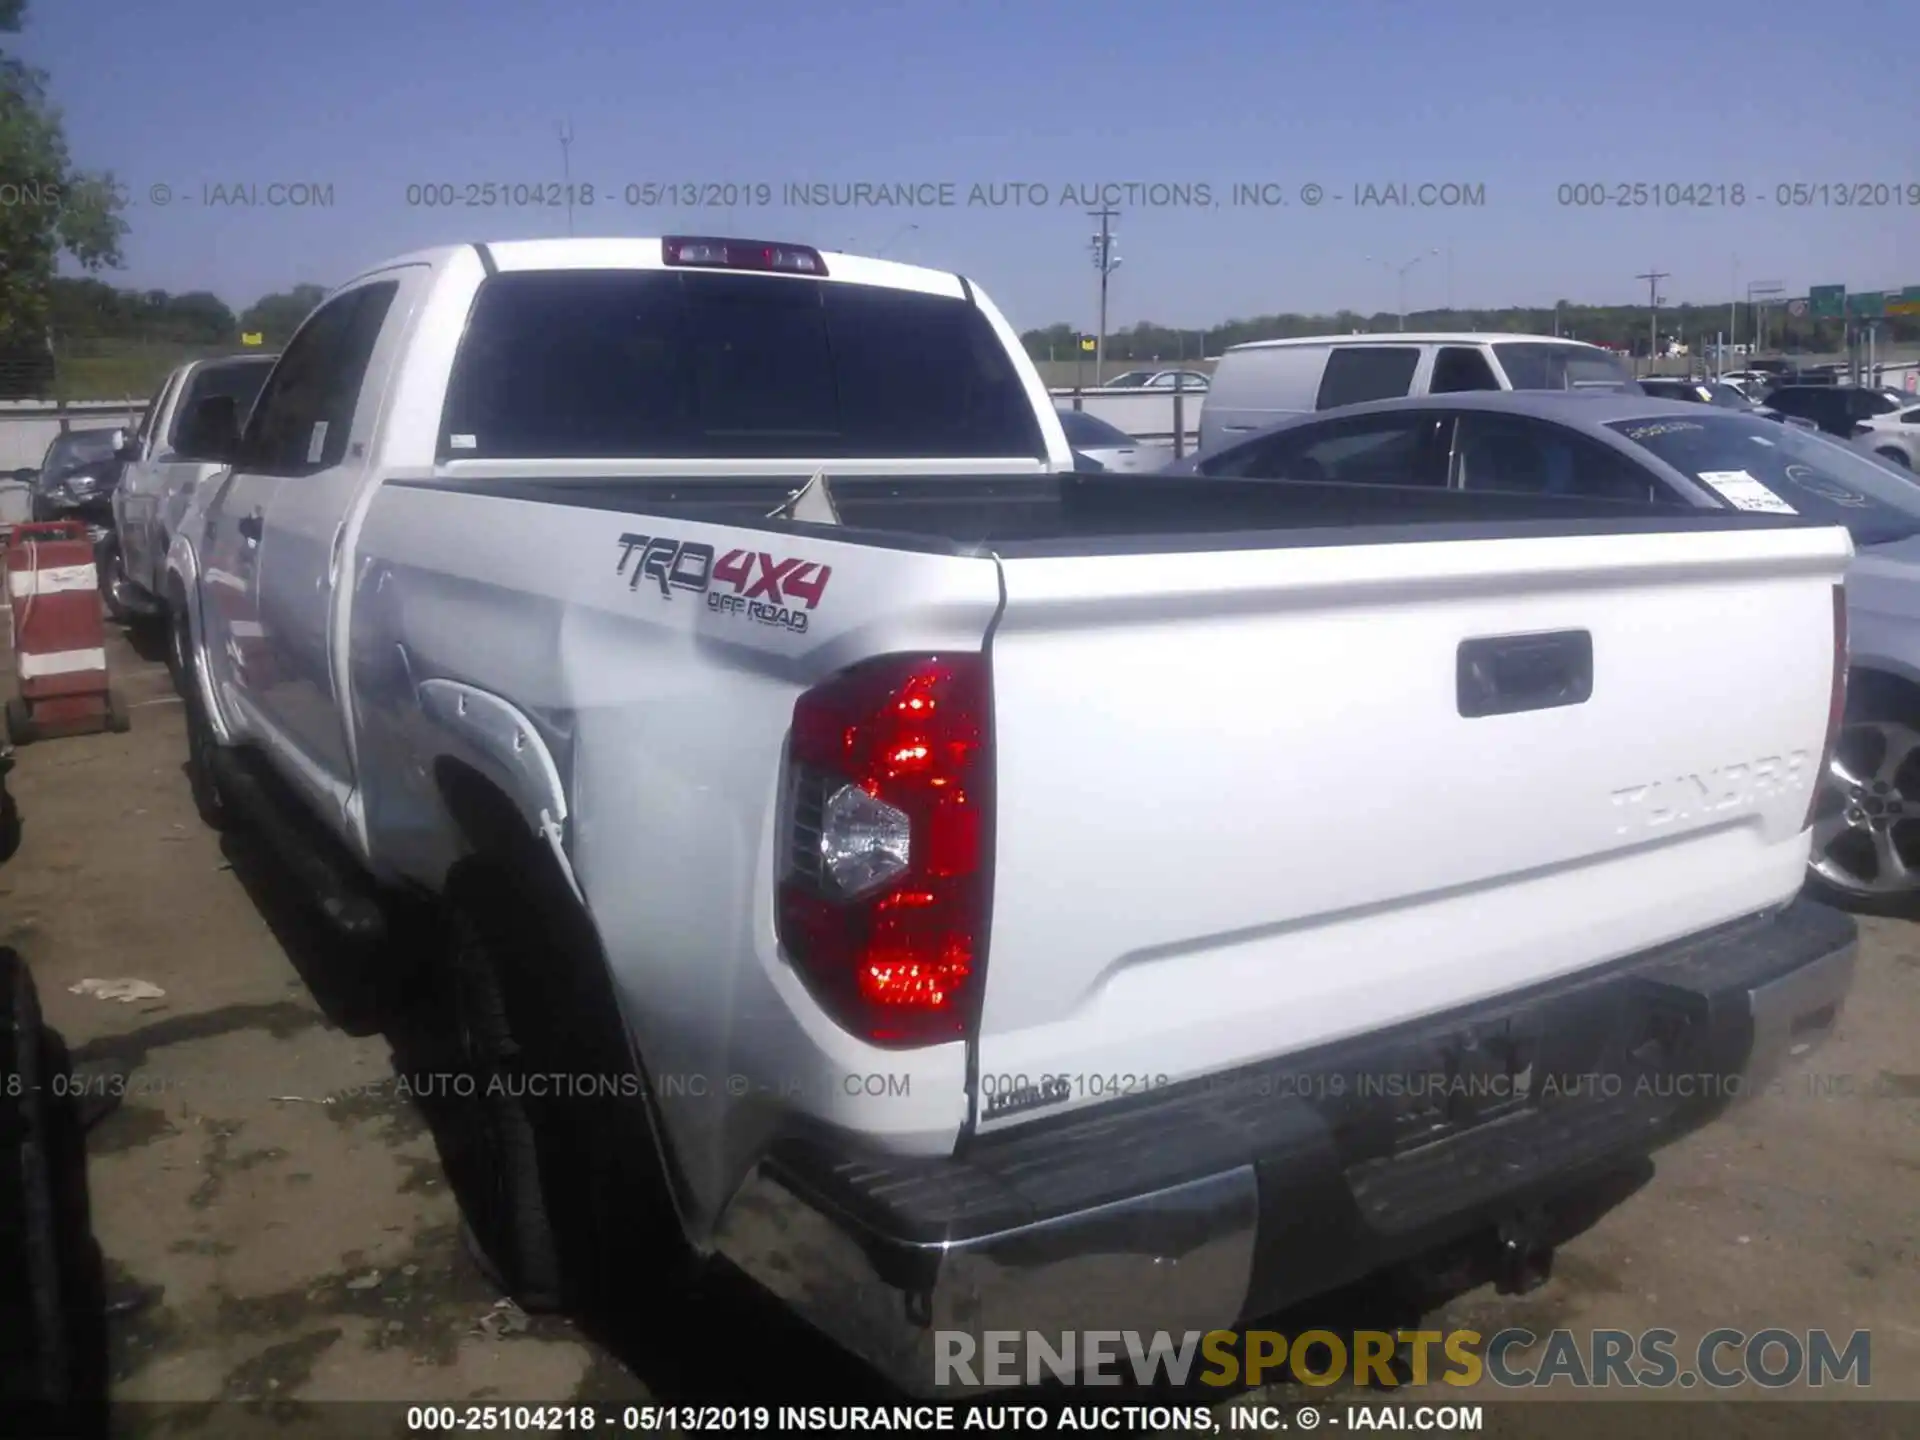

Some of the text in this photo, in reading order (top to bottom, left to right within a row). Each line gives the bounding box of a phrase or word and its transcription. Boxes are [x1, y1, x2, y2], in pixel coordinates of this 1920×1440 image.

[616, 532, 832, 610] TRD 4X4
[707, 591, 809, 634] OFF ROAD
